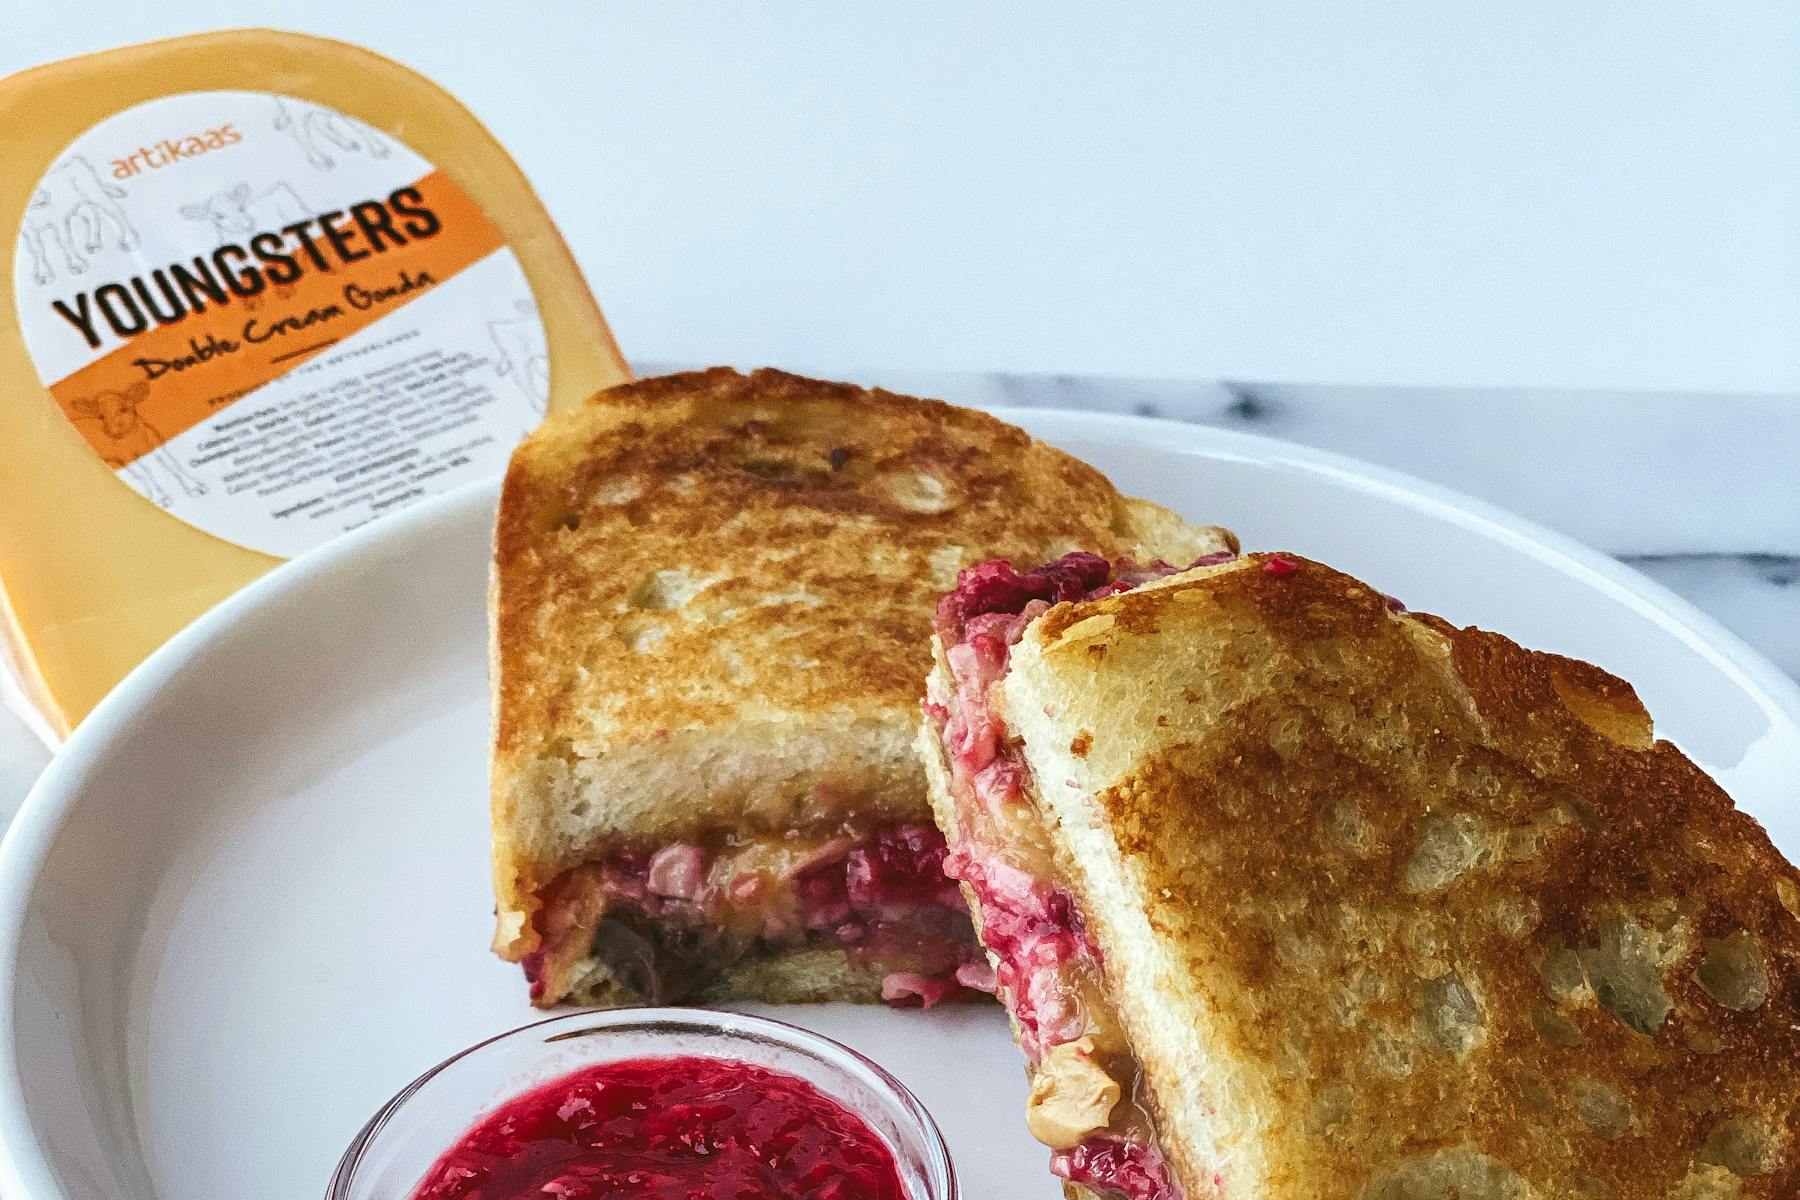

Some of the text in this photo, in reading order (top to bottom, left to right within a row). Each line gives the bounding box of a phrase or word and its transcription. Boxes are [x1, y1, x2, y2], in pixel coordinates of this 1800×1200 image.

[112, 122, 243, 180] artikaas
[52, 185, 442, 349] YOUNGSTERS
[133, 335, 240, 380] Double
[242, 305, 344, 344] Cream
[343, 270, 435, 311] Gouda
